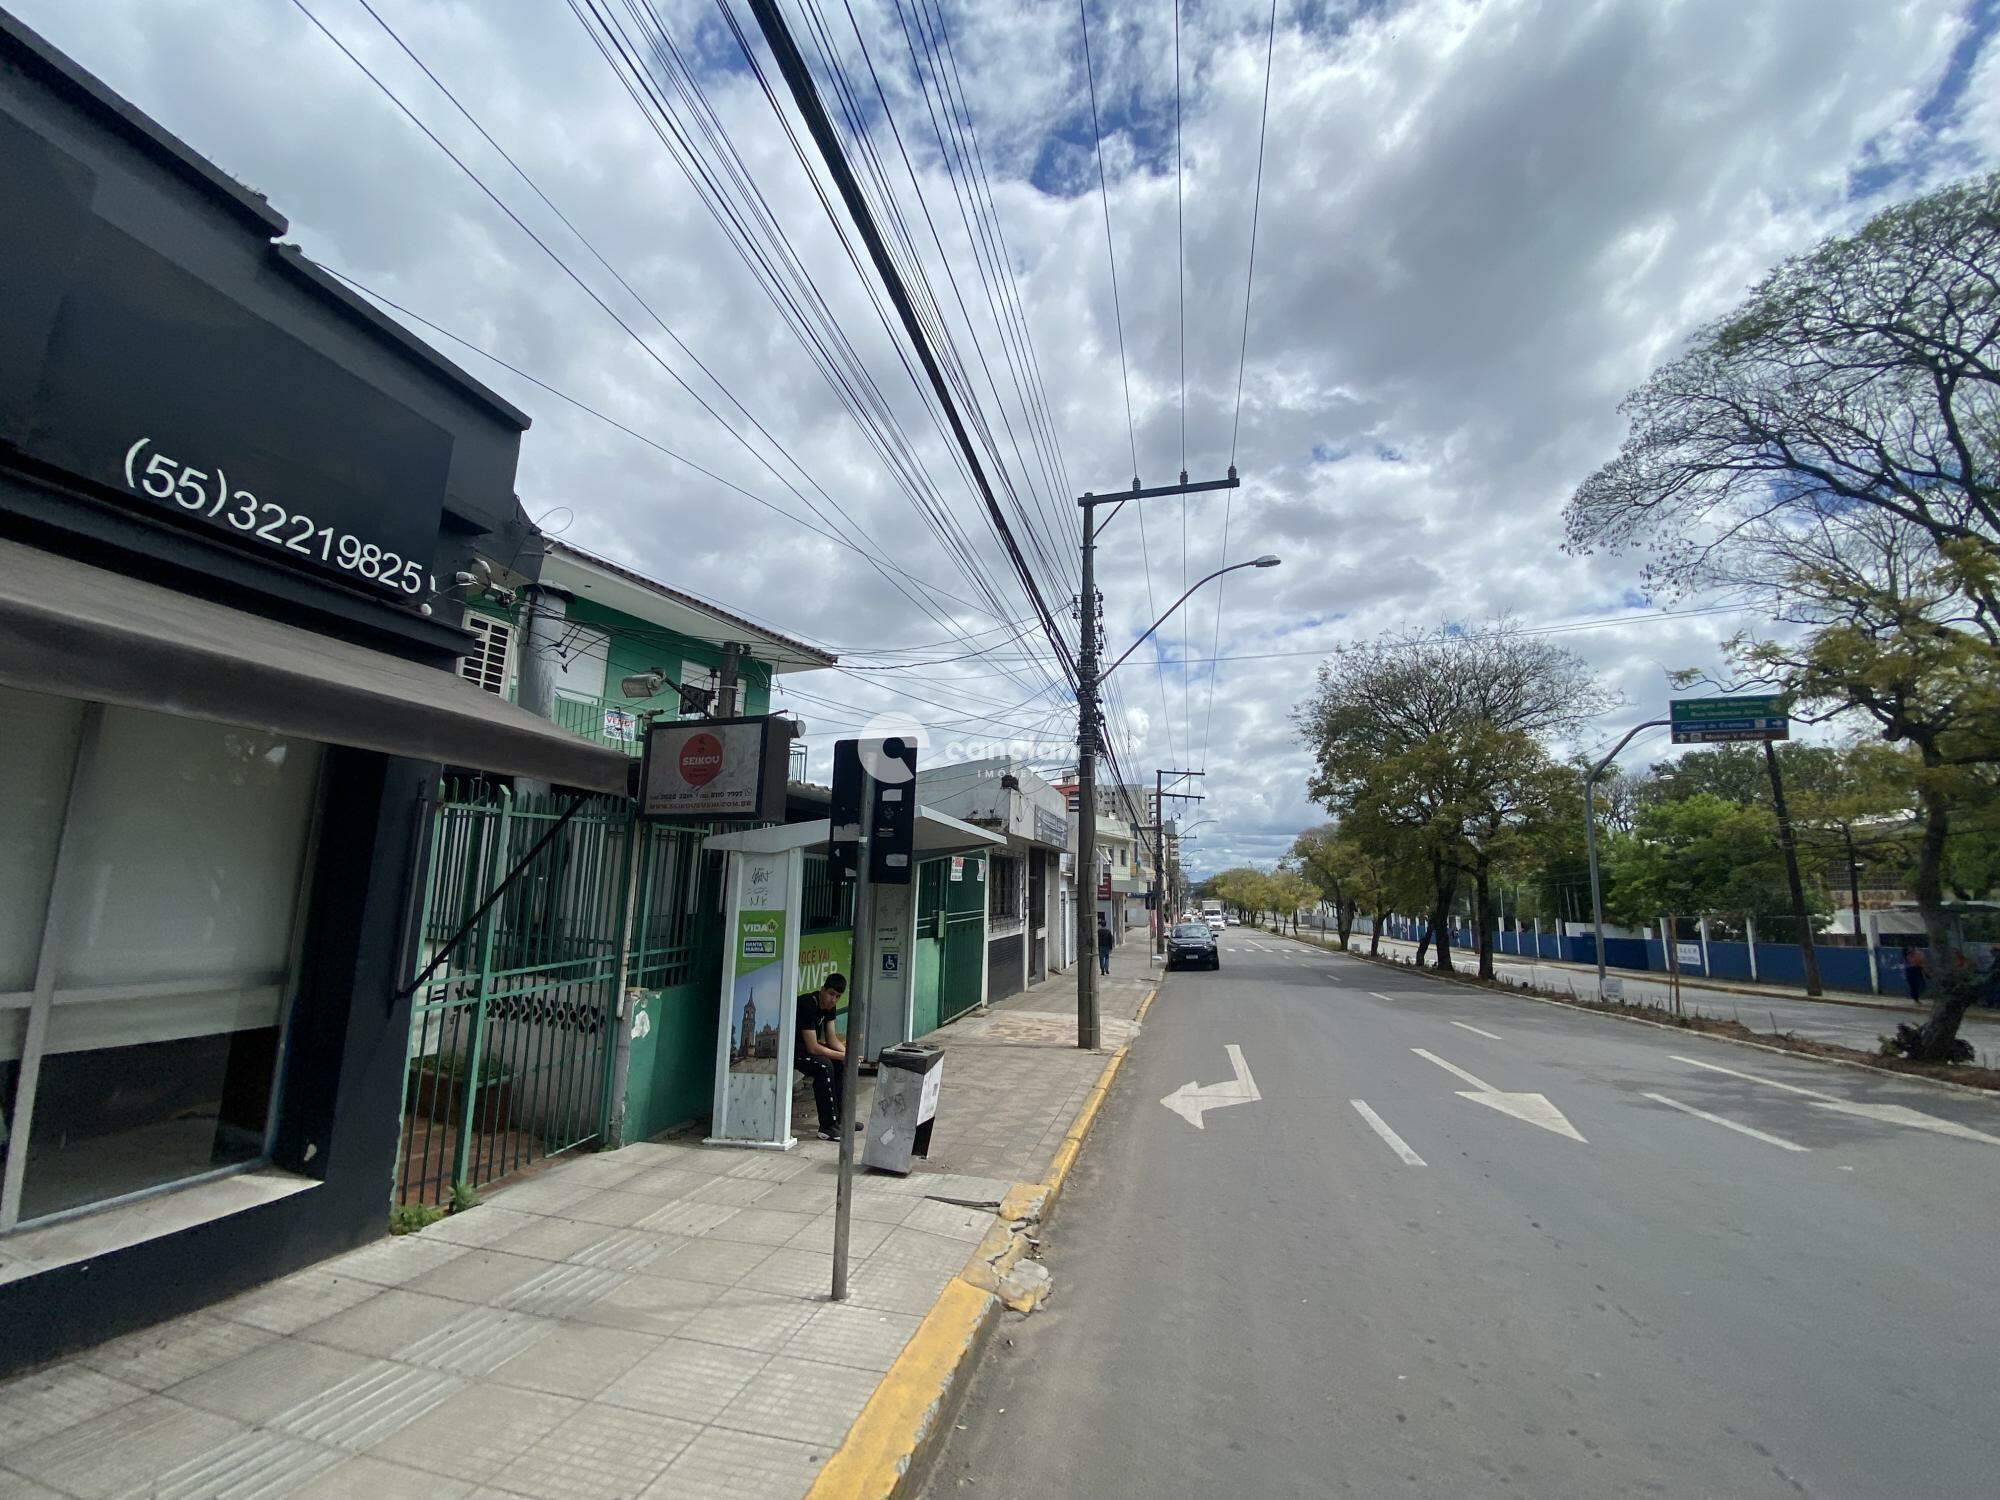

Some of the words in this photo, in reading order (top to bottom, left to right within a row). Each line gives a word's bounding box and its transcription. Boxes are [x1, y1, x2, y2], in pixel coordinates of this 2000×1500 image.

[124, 437, 423, 594] (55)32219825
[743, 923, 768, 933] VIDA
[818, 947, 830, 962] VAI
